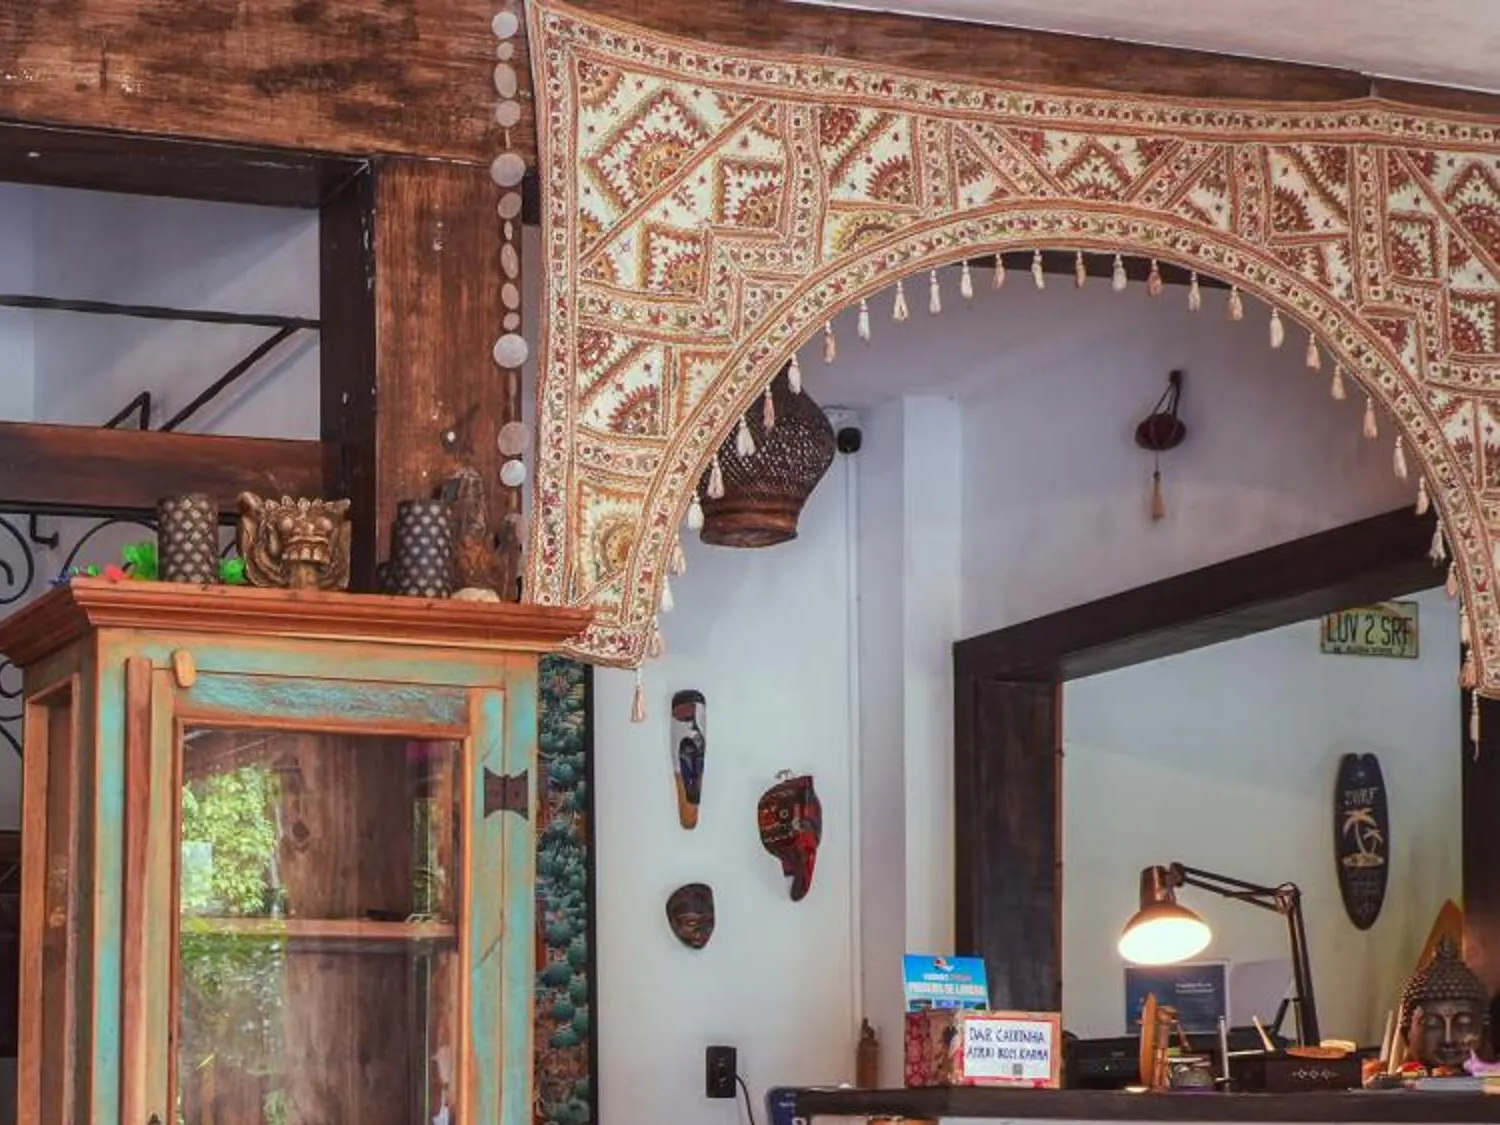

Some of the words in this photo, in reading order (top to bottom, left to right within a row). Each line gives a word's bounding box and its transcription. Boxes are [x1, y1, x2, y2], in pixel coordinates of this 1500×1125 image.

[1326, 612, 1359, 643] LUV
[1364, 613, 1376, 645] 2
[1381, 615, 1413, 646] SRF
[969, 1026, 993, 1042] DAR
[1018, 1047, 1049, 1061] KARMA
